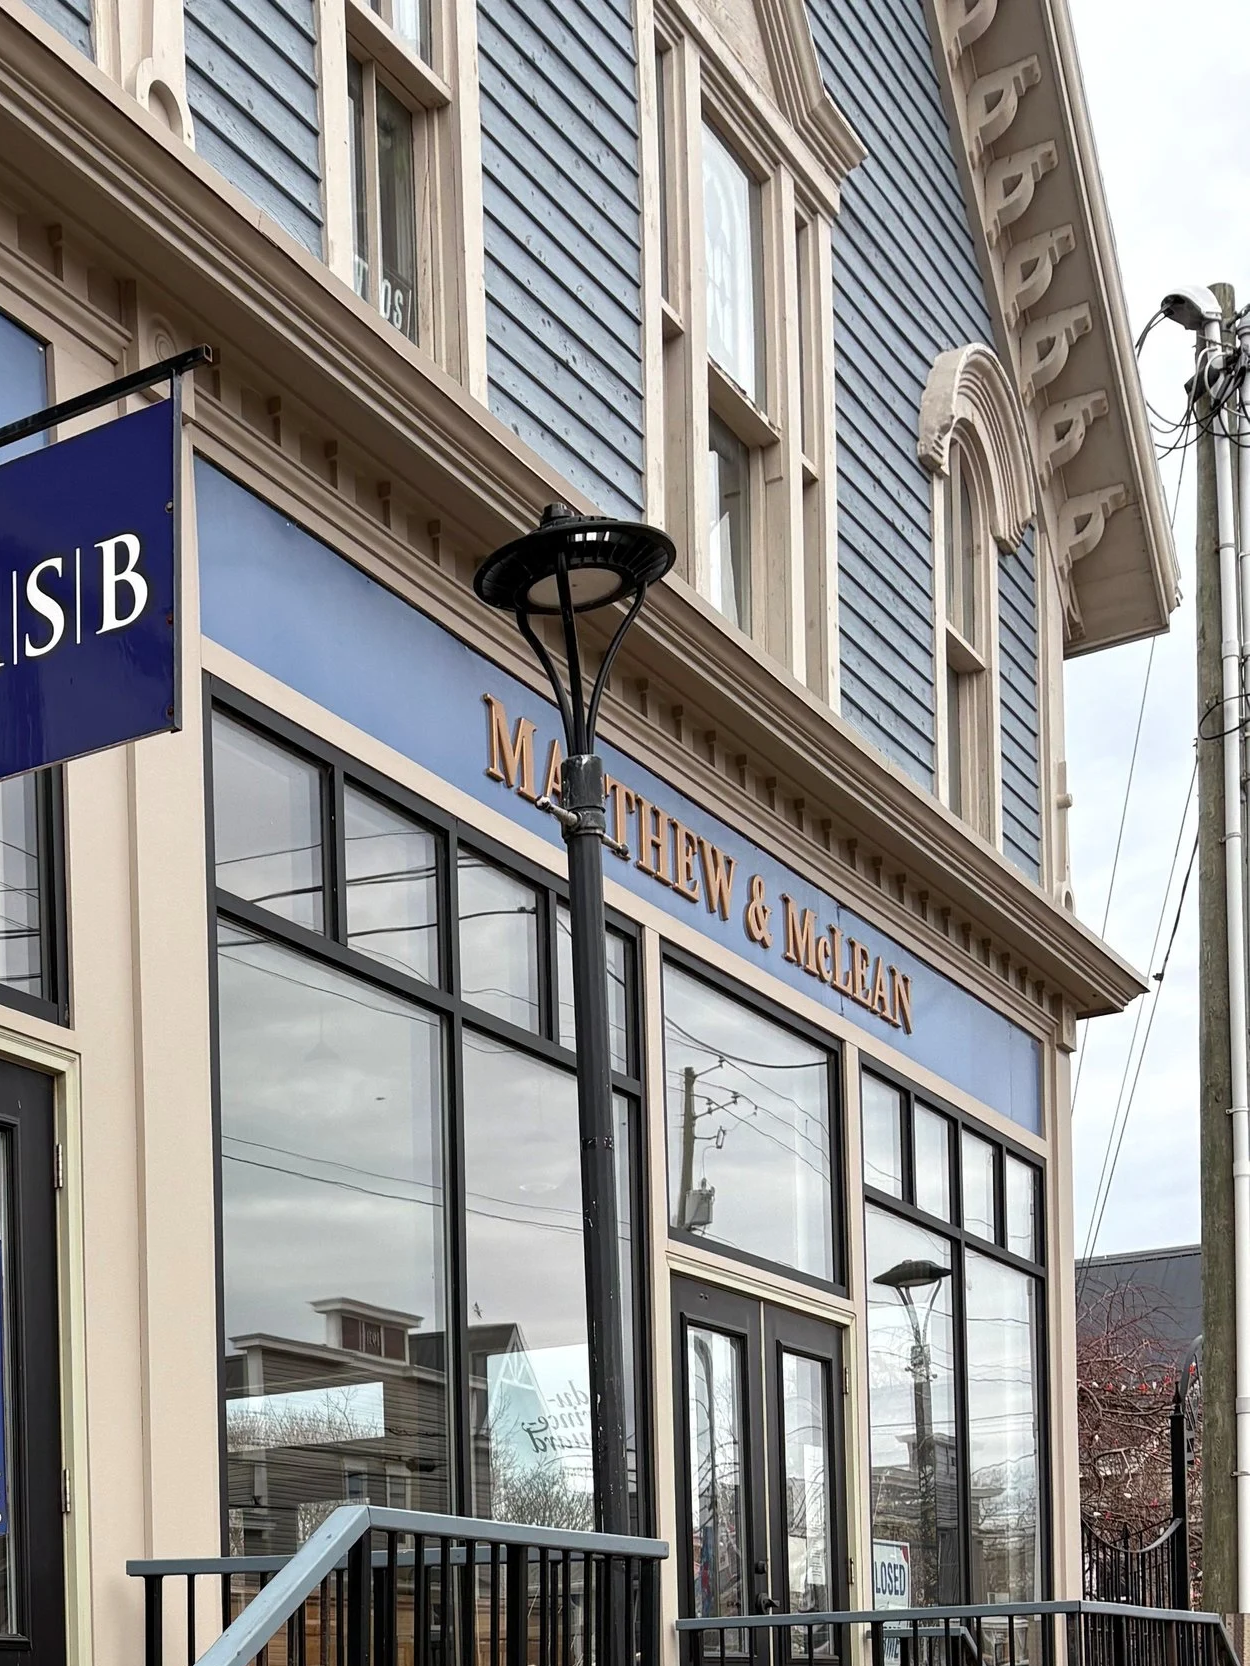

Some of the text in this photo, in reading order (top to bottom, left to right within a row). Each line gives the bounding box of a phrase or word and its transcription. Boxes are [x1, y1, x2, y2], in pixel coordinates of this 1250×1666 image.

[482, 693, 913, 1036] MATHEW & McLEAN
[874, 1561, 906, 1596] LOSED
